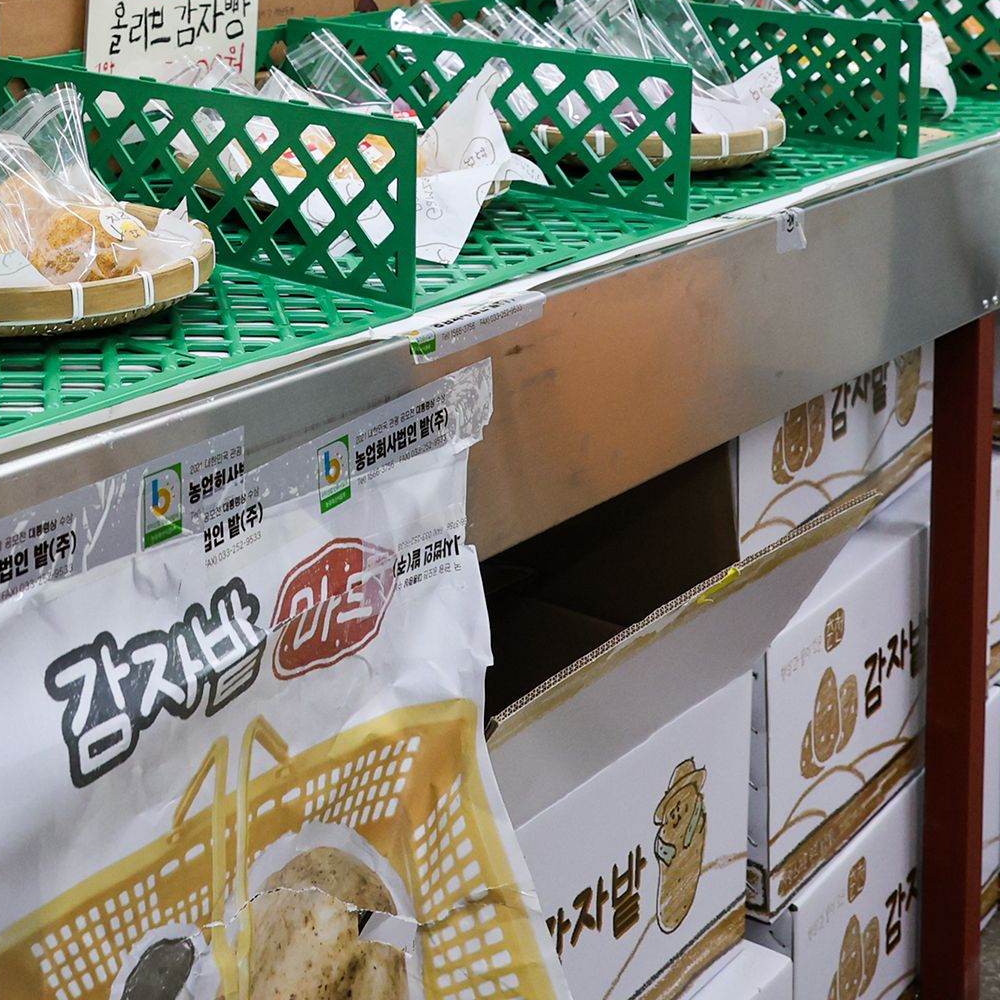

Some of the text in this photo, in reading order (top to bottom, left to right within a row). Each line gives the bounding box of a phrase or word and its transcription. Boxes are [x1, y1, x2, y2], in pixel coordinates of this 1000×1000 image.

[109, 1, 171, 55] 올리브
[355, 407, 449, 471] 농업회사법인 밭(주)
[228, 502, 263, 539] 밭(주)
[34, 530, 76, 569] 밭(주)
[47, 572, 373, 785] 감자밭 마트
